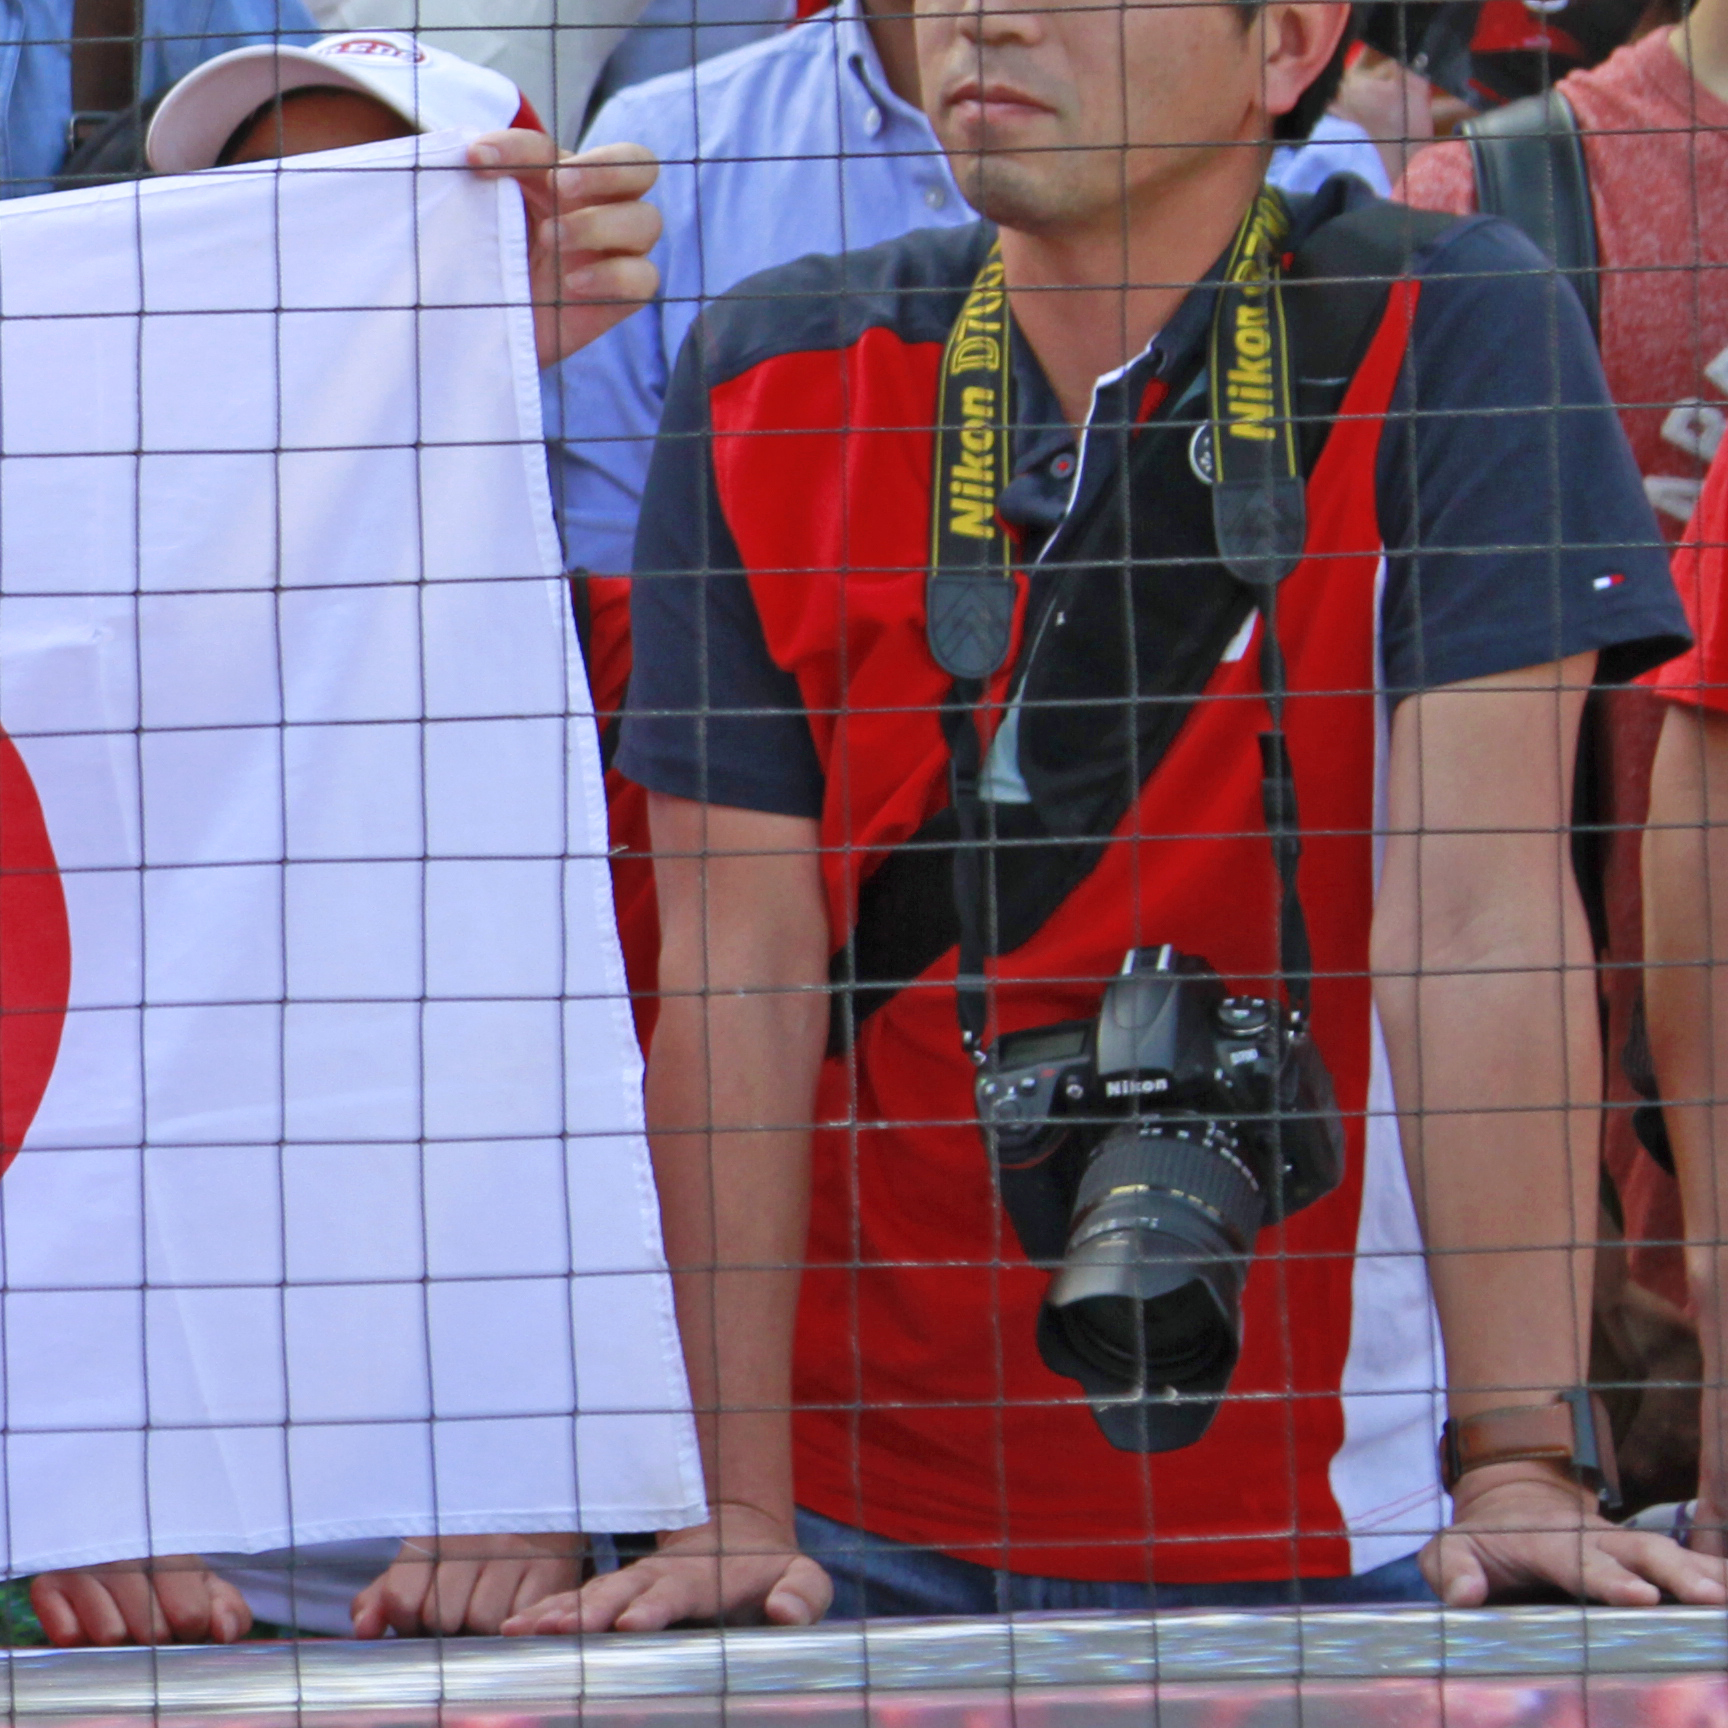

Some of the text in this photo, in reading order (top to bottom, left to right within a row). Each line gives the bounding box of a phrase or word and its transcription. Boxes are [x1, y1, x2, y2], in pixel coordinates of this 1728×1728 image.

[1226, 303, 1278, 441] Nikon
[948, 383, 998, 540] Nikon
[1105, 1078, 1169, 1098] Nikon
